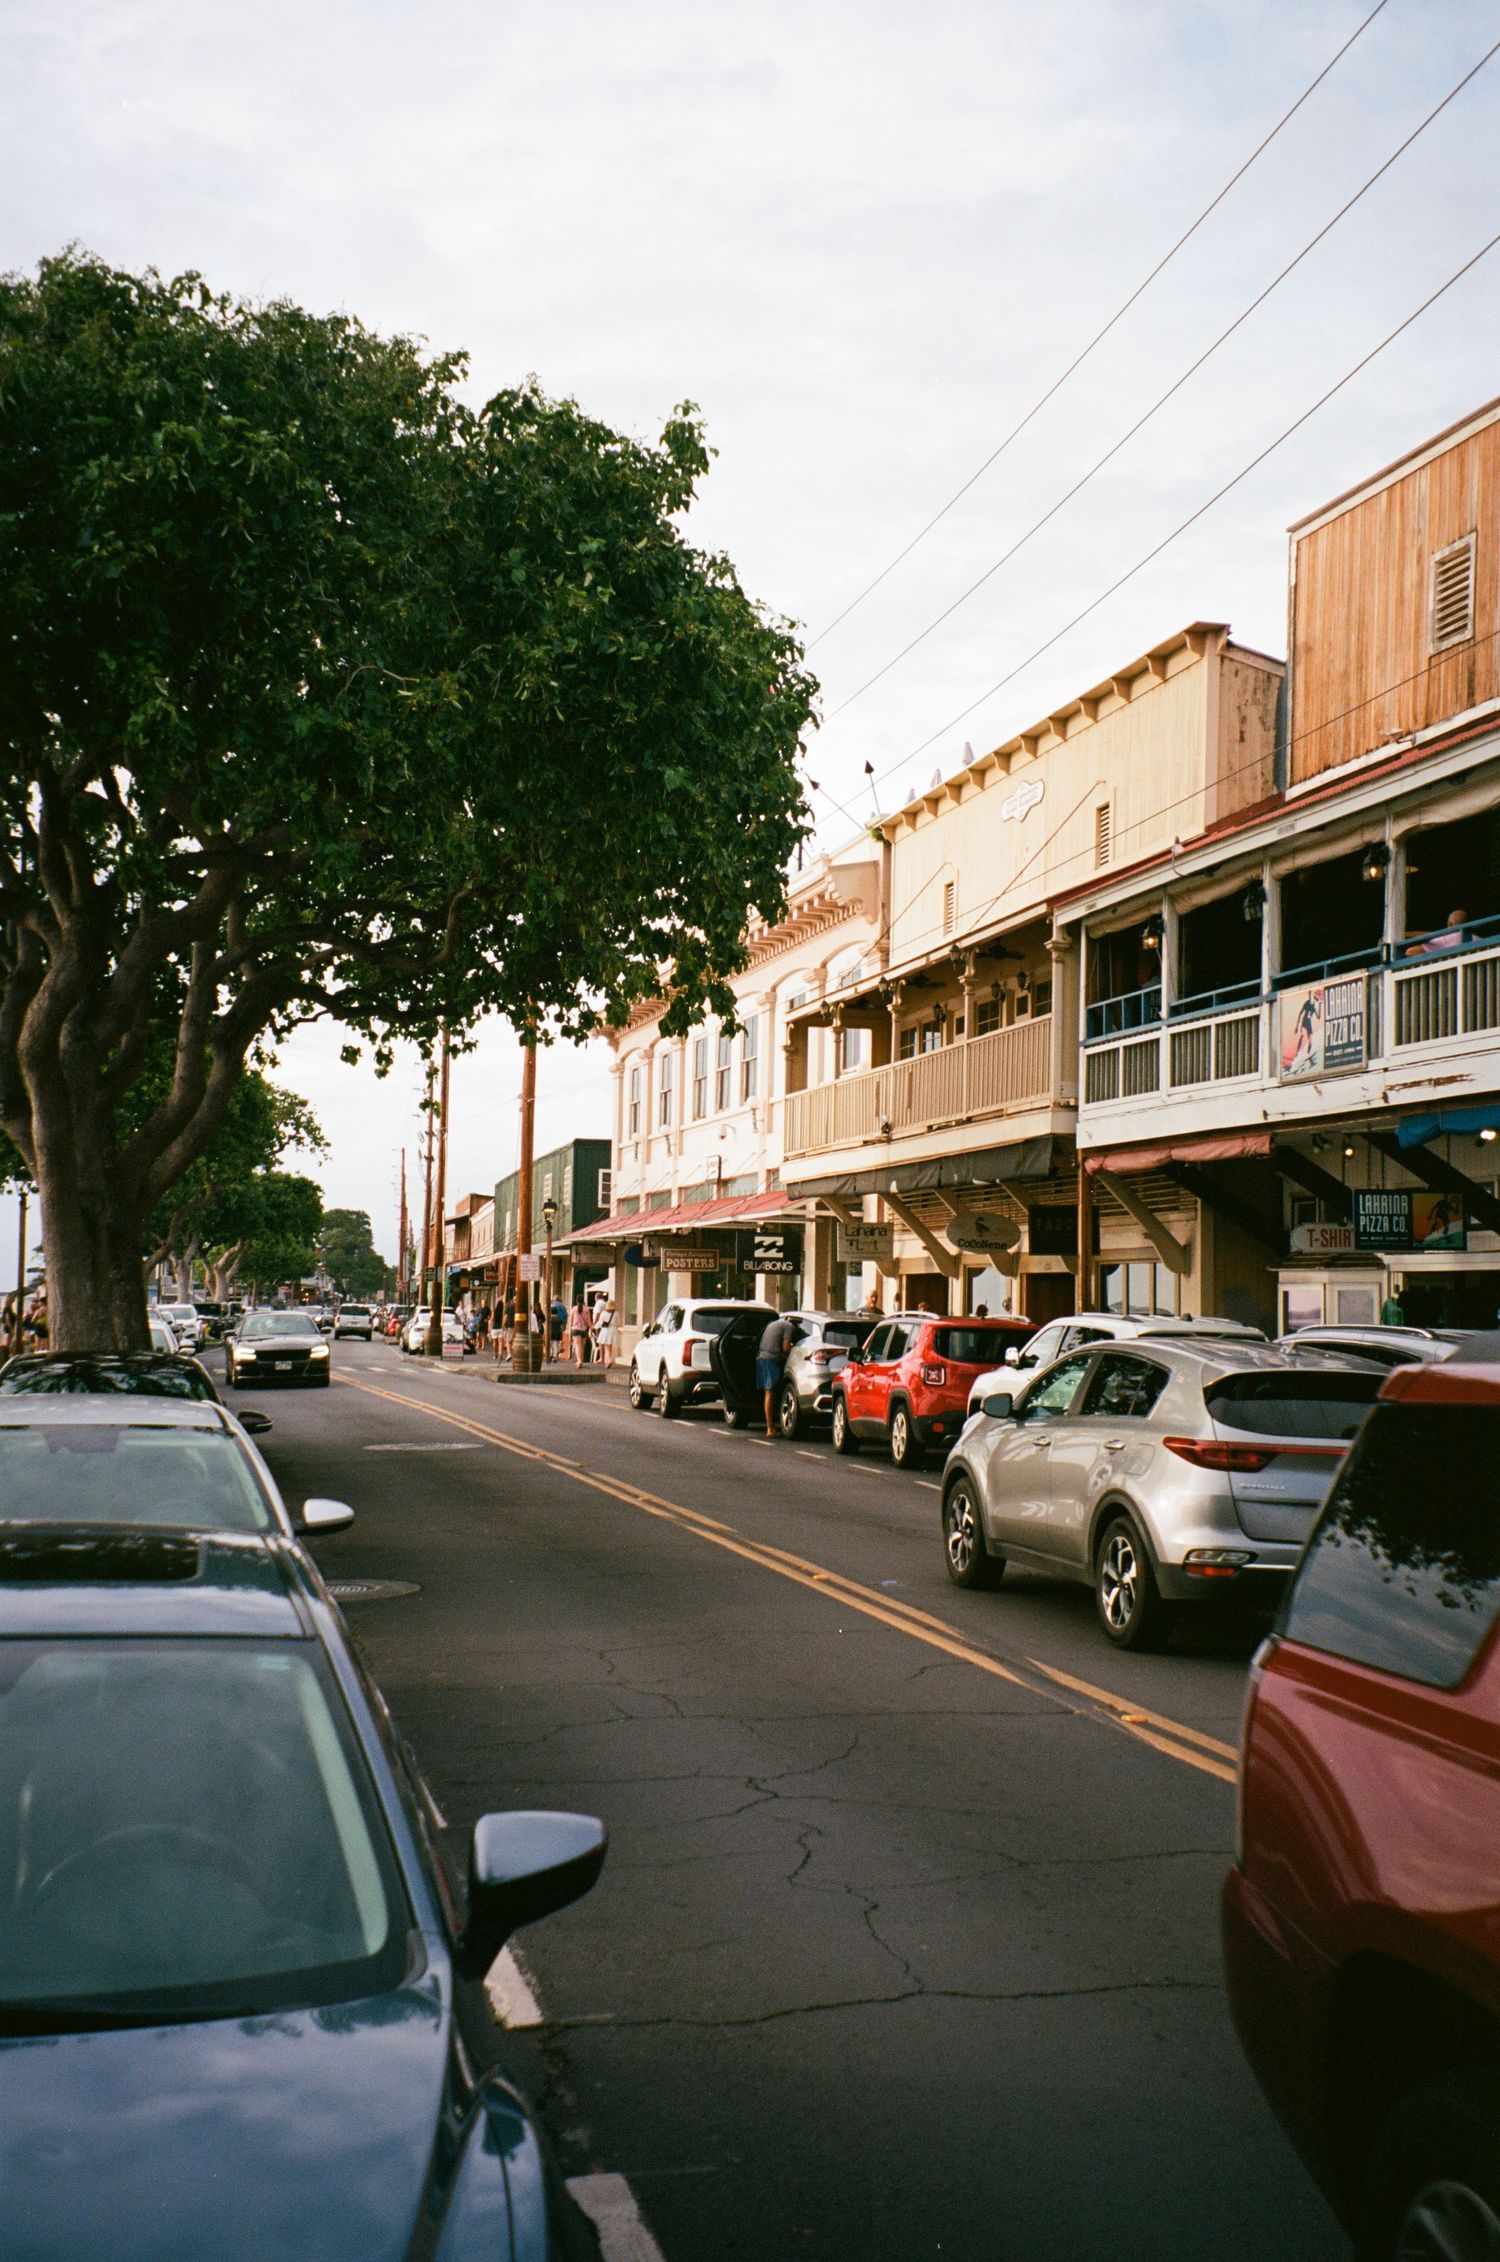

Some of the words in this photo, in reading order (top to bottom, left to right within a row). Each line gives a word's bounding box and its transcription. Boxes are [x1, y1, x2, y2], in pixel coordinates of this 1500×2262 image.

[1325, 981, 1363, 1020] LAHAINA
[1325, 1018, 1348, 1046] PIZZA
[1350, 1015, 1363, 1042] CO.
[1359, 1194, 1408, 1214] LAHAINA
[845, 1224, 887, 1237] Lahaina
[1360, 1216, 1389, 1232] PIZZA
[1393, 1216, 1408, 1233] CO.
[1307, 1228, 1353, 1248] T-SHIR
[666, 1258, 715, 1268] POSTERS
[743, 1260, 793, 1272] BILLABONG
